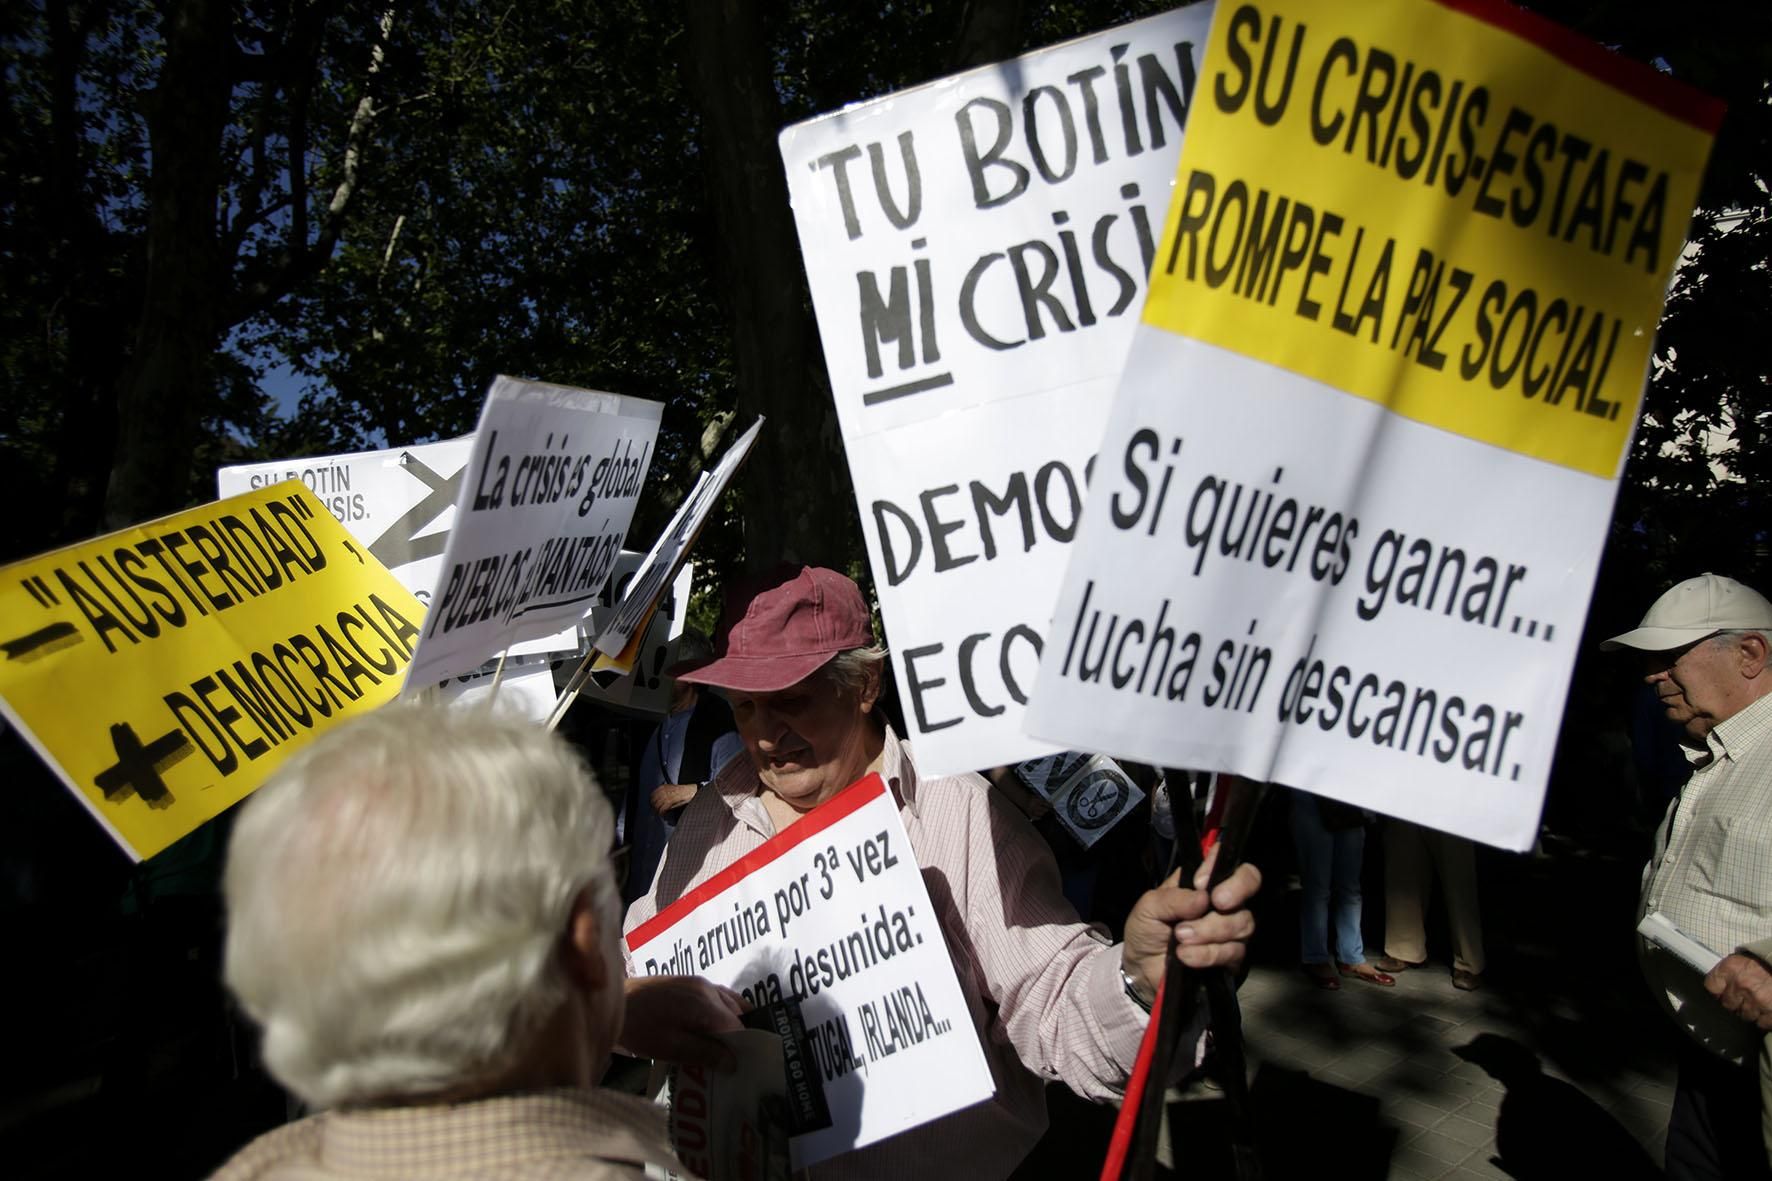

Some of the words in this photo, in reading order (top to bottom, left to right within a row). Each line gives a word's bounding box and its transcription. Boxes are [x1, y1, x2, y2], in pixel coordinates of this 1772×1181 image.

[808, 130, 923, 241] TU
[955, 41, 1195, 210] BOTÍN
[1213, 3, 1308, 126] SU
[1310, 36, 1670, 274] CRISIS-ESTAFA
[856, 237, 942, 379] MI
[958, 182, 1156, 351] CRISI
[1166, 169, 1345, 322] ROMPE
[1331, 226, 1396, 344] LA
[1390, 247, 1475, 372] PAZ
[1459, 279, 1622, 422] SOCIAL.
[286, 458, 352, 494] OTÍN
[472, 430, 511, 512] La
[511, 432, 572, 507] crisis
[872, 453, 1099, 587] DEMO
[1110, 428, 1183, 537] Si
[1184, 467, 1360, 577] quieres
[1356, 527, 1556, 643] ganar...
[163, 592, 420, 777] DEMOCRACIA
[902, 623, 1045, 734] ECO
[1060, 579, 1202, 702] lucha
[1202, 618, 1273, 713] sin
[1277, 633, 1525, 782] descansar.
[697, 898, 771, 971] arruina
[773, 873, 811, 940] por
[846, 828, 899, 884] vez
[790, 904, 925, 1003] desunida:
[775, 1006, 795, 1059] TROIKA
[788, 1060, 805, 1079] GO
[807, 1013, 869, 1083] TUGAL,
[857, 981, 953, 1063] IRLANDA...
[794, 1080, 816, 1121] HOME
